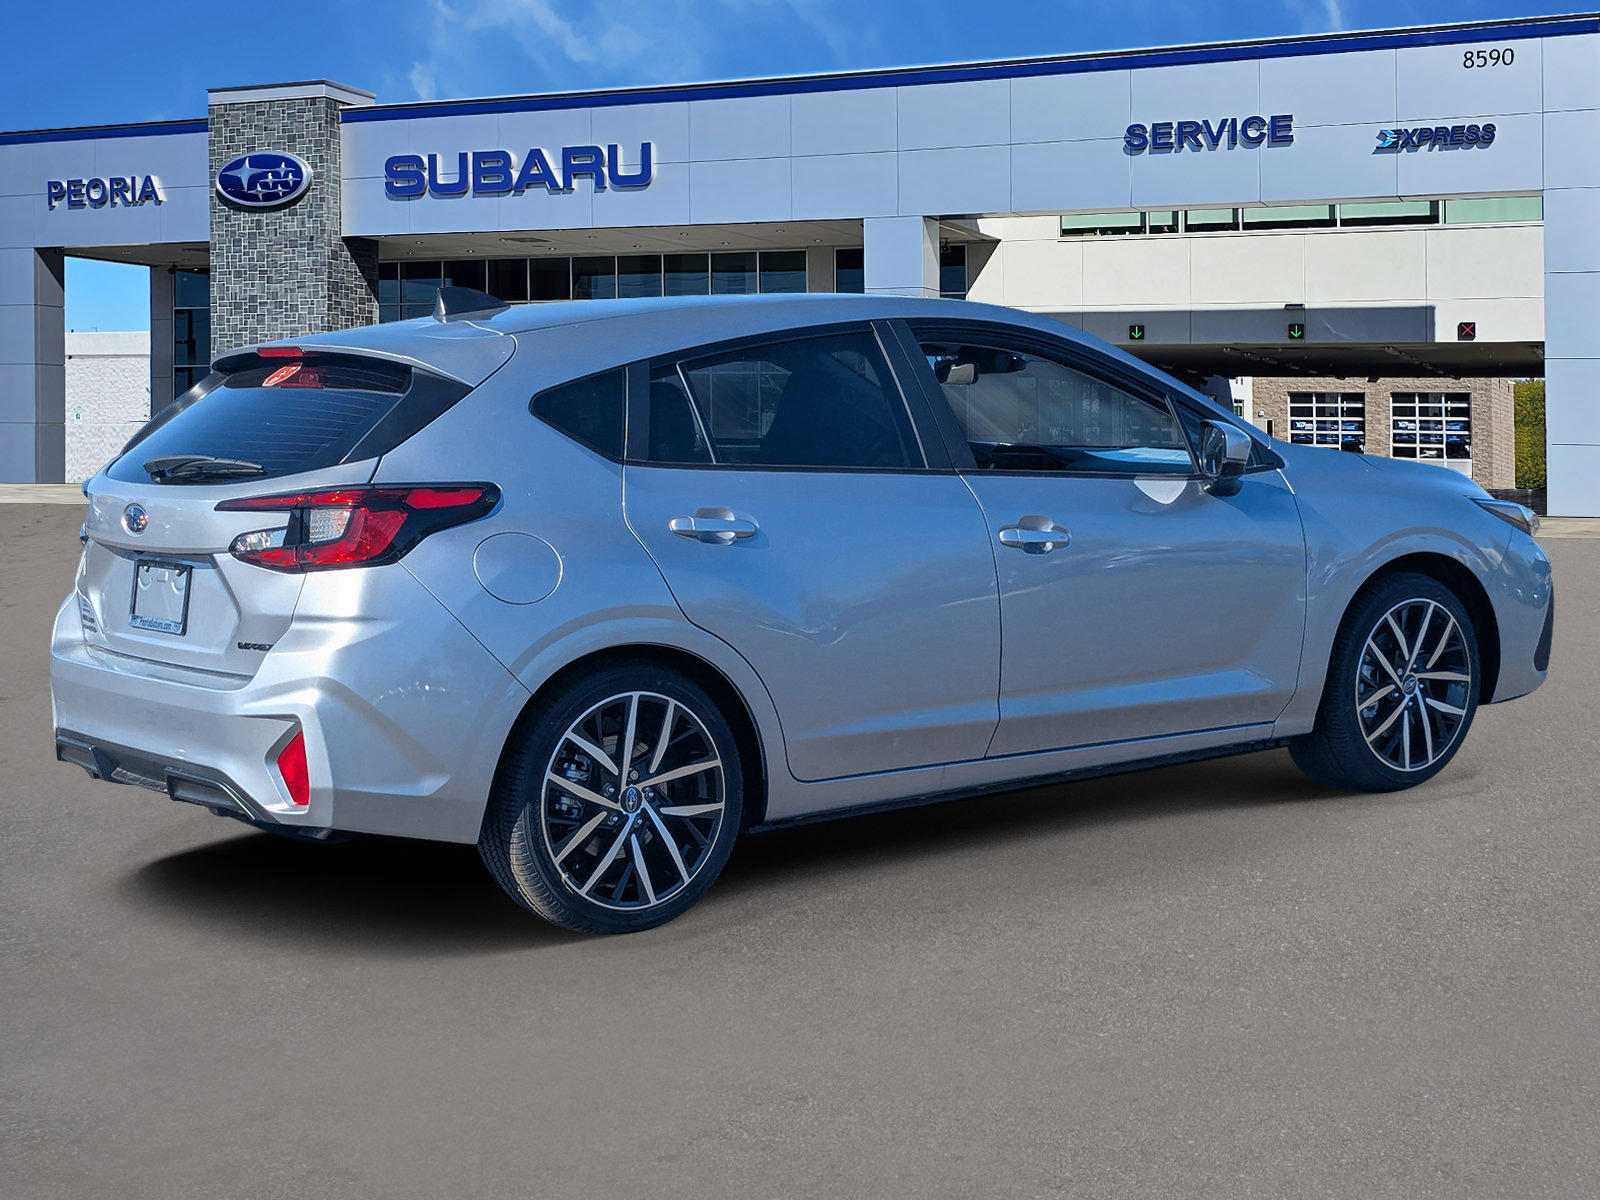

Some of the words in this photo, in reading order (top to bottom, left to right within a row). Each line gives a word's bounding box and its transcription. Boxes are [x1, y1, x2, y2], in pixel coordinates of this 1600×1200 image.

[1463, 48, 1514, 68] 8590
[1125, 114, 1294, 150] SERVICE
[1376, 123, 1497, 148] EXPRESS
[385, 142, 652, 197] SUBARU
[48, 175, 163, 210] PEORIA
